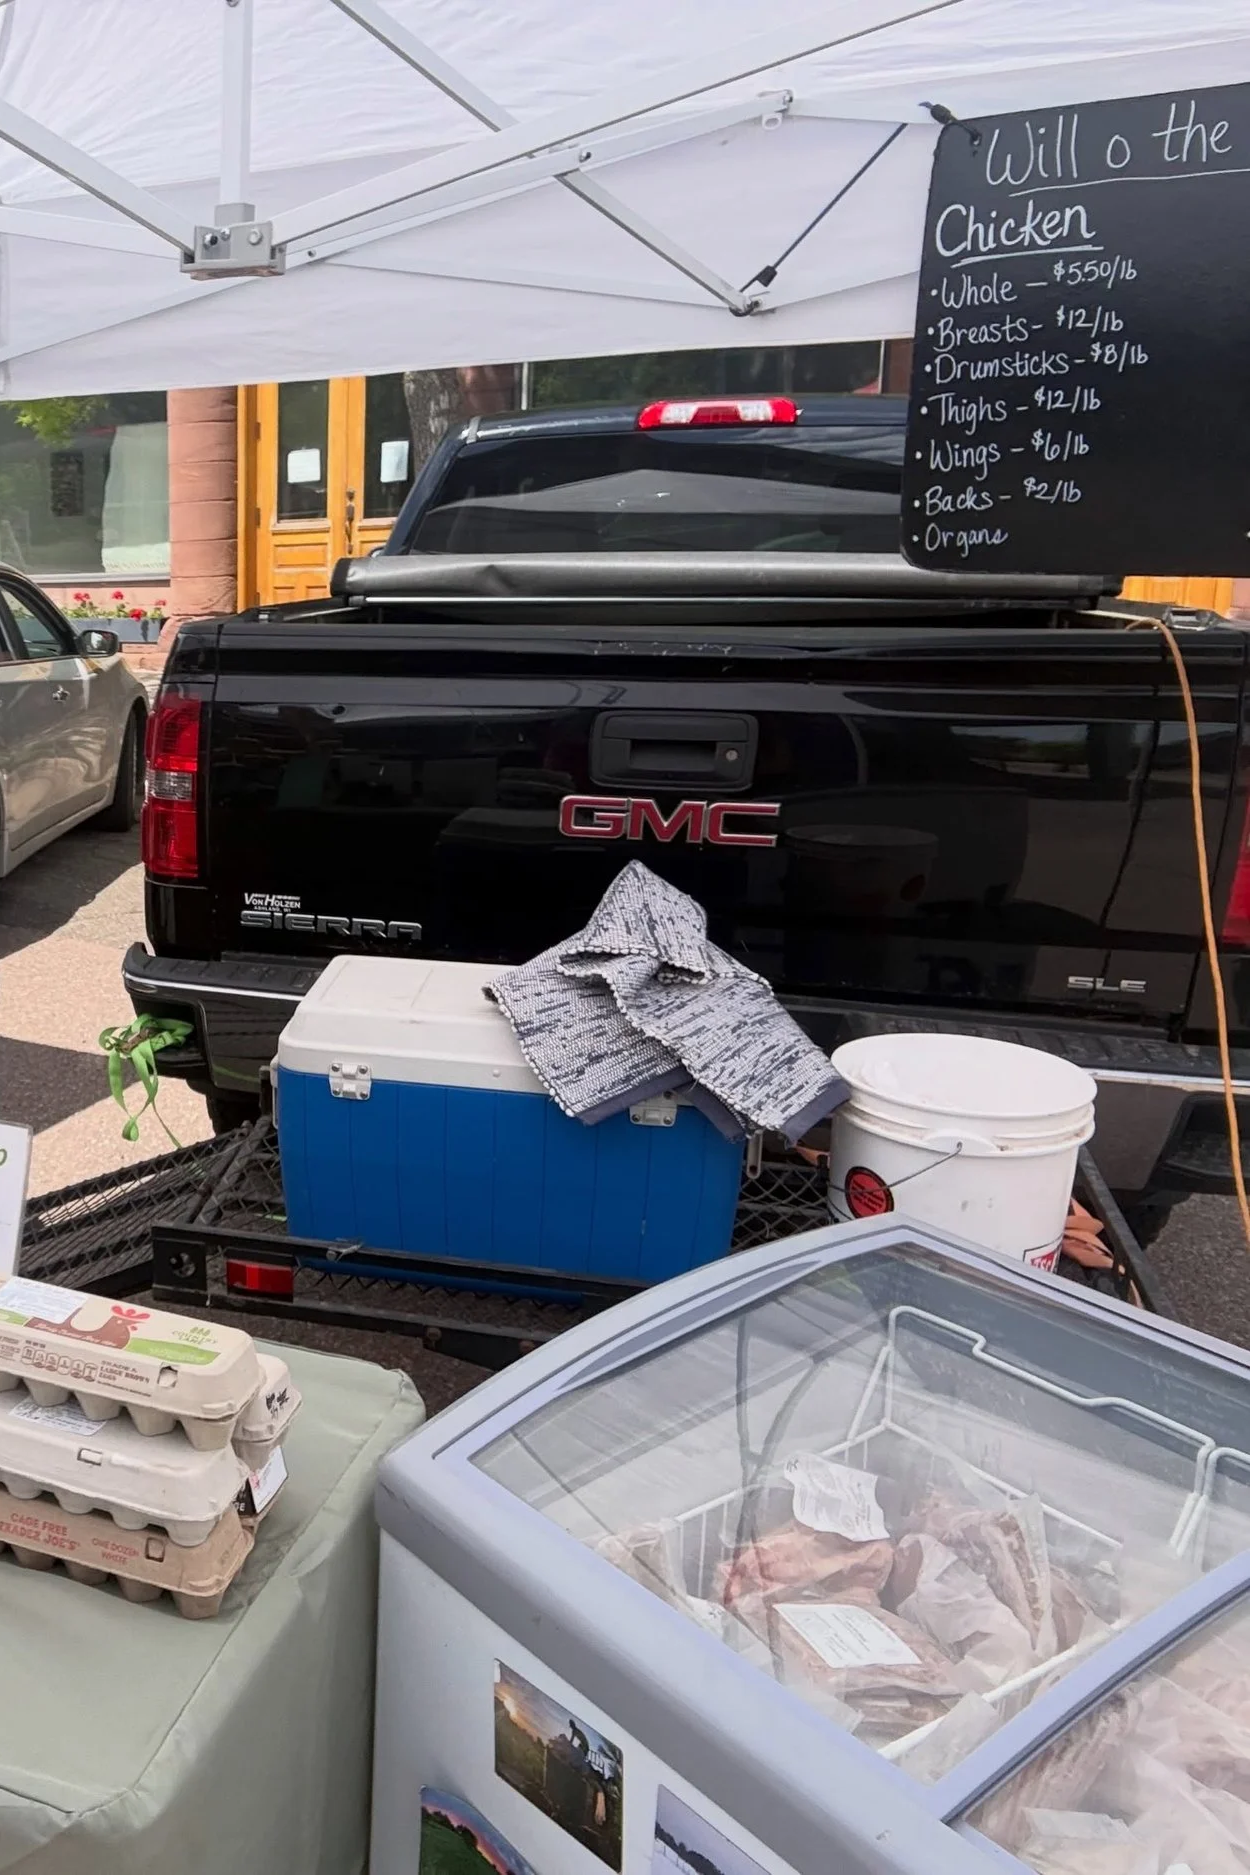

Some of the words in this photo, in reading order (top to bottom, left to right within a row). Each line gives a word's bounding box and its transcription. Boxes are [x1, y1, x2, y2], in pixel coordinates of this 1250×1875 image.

[986, 114, 1078, 187] Will
[1107, 134, 1131, 169] o
[1152, 100, 1232, 163] the
[936, 200, 1096, 258] Chicken
[941, 274, 1017, 309] Whole
[1053, 259, 1137, 290] $5.50/lb
[1056, 305, 1124, 338] $12/lb
[935, 350, 1070, 384] Drumsticks
[1090, 342, 1149, 373] $8/lb
[927, 392, 1007, 435] Thighs
[1034, 385, 1102, 414] $12/lb
[929, 438, 1001, 481] Wings
[1031, 428, 1090, 462] $6/lb
[925, 486, 994, 517] Backs
[1023, 477, 1082, 506] $2/lb
[925, 523, 1008, 557] Organs
[558, 794, 781, 848] GMC
[240, 910, 422, 941] SIERRA
[1067, 976, 1146, 992] SLE
[10, 1512, 39, 1528] CAGE
[42, 1520, 69, 1537] FREE
